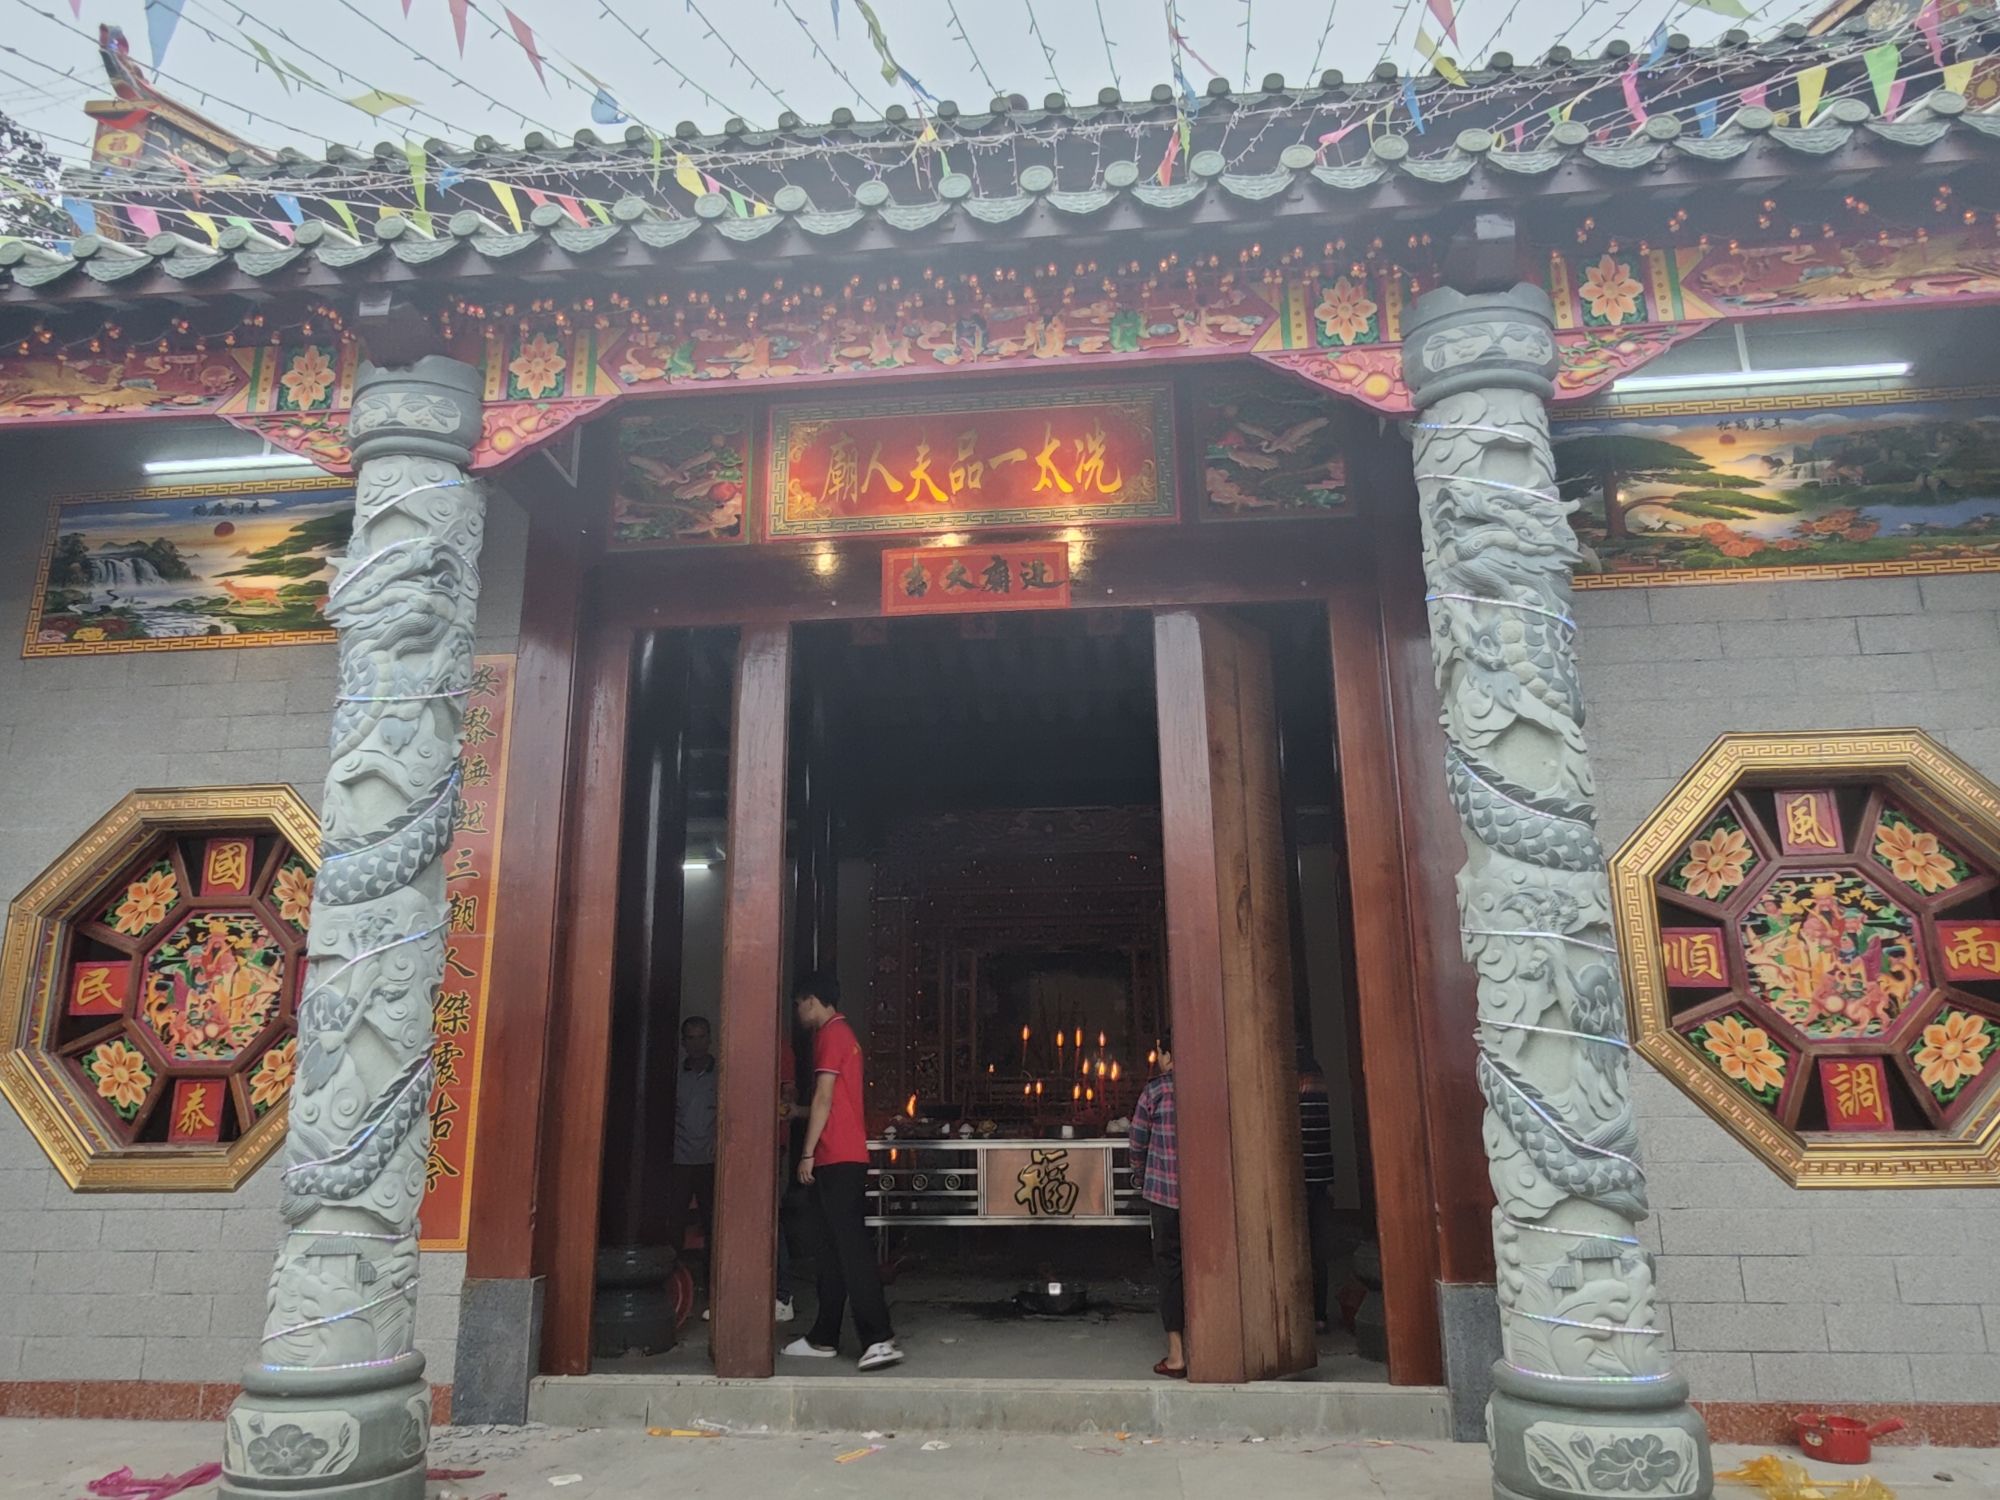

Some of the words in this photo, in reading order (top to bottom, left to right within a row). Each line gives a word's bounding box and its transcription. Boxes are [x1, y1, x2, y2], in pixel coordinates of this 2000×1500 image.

[1785, 793, 1836, 849] 風
[208, 843, 247, 890] 國
[1663, 933, 1722, 980] 順
[1945, 927, 2000, 974] 雨
[76, 967, 122, 1009] 民
[176, 1083, 216, 1136] 泰
[1829, 1063, 1883, 1122] 調
